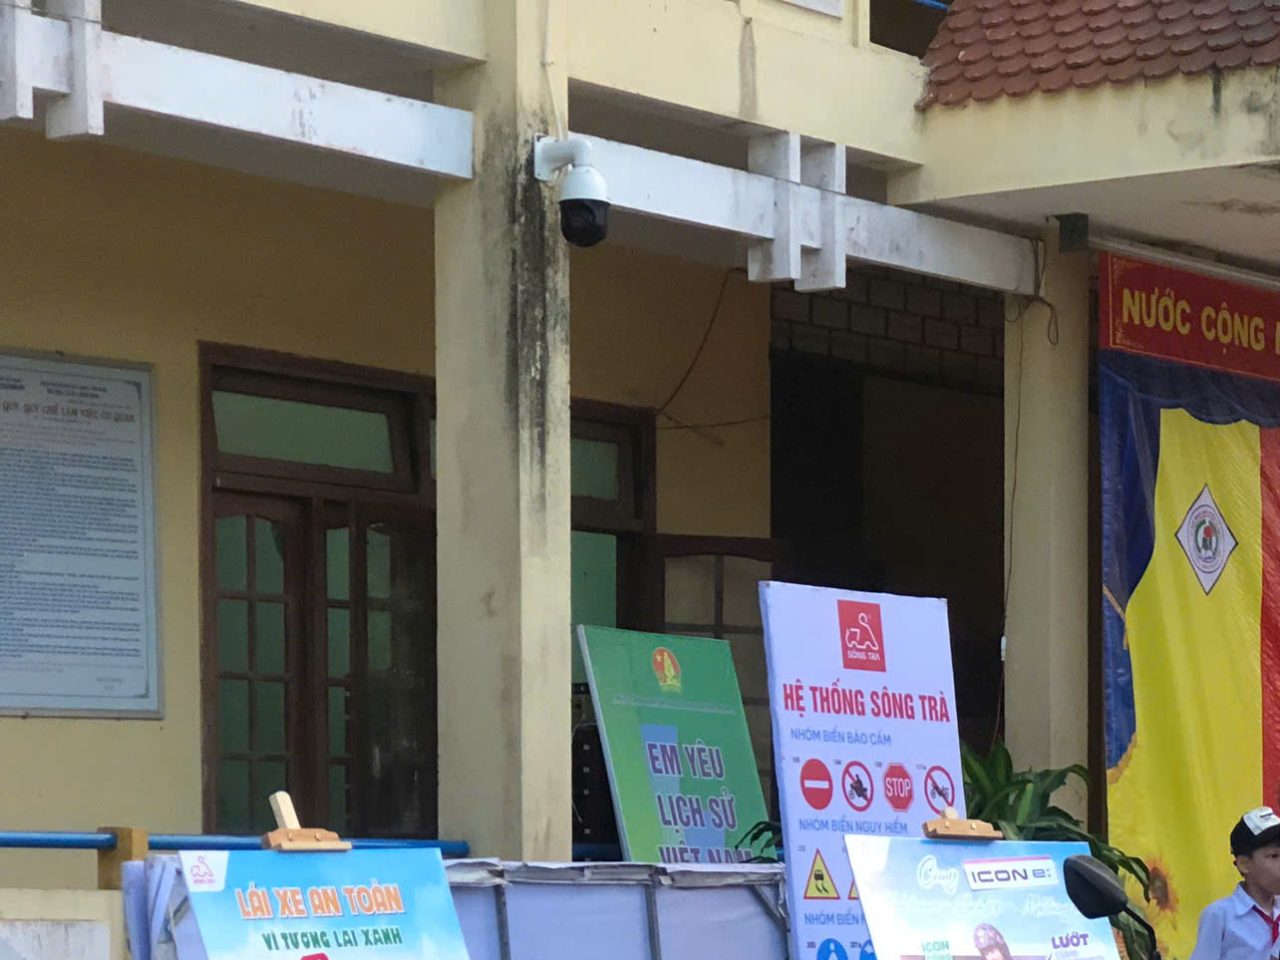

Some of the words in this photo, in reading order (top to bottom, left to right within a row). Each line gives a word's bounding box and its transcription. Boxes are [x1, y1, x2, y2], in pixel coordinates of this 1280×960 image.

[1122, 287, 1191, 335] NƯỚC
[1201, 302, 1265, 355] CỘNG
[783, 678, 806, 718] HỆ
[809, 678, 866, 716] THỐNG
[870, 686, 915, 720] SÔNG
[918, 690, 950, 722] TRÀ
[790, 726, 821, 742] NHÓM
[647, 743, 683, 777] EM
[683, 738, 725, 779] YÊU
[885, 777, 911, 797] STOP
[657, 795, 705, 833] LỊCH
[708, 787, 737, 831] SỬ
[799, 816, 829, 831] NHÓM
[855, 821, 882, 833] NGUY
[971, 867, 1029, 883] ICON
[235, 881, 273, 920] LÁI
[273, 887, 307, 917] XE
[308, 885, 342, 917] AN
[343, 878, 404, 915] TOÀN
[804, 910, 835, 925] NHÓM
[262, 930, 279, 951] VÌ
[333, 929, 357, 947] LAI
[361, 927, 402, 946] XANH
